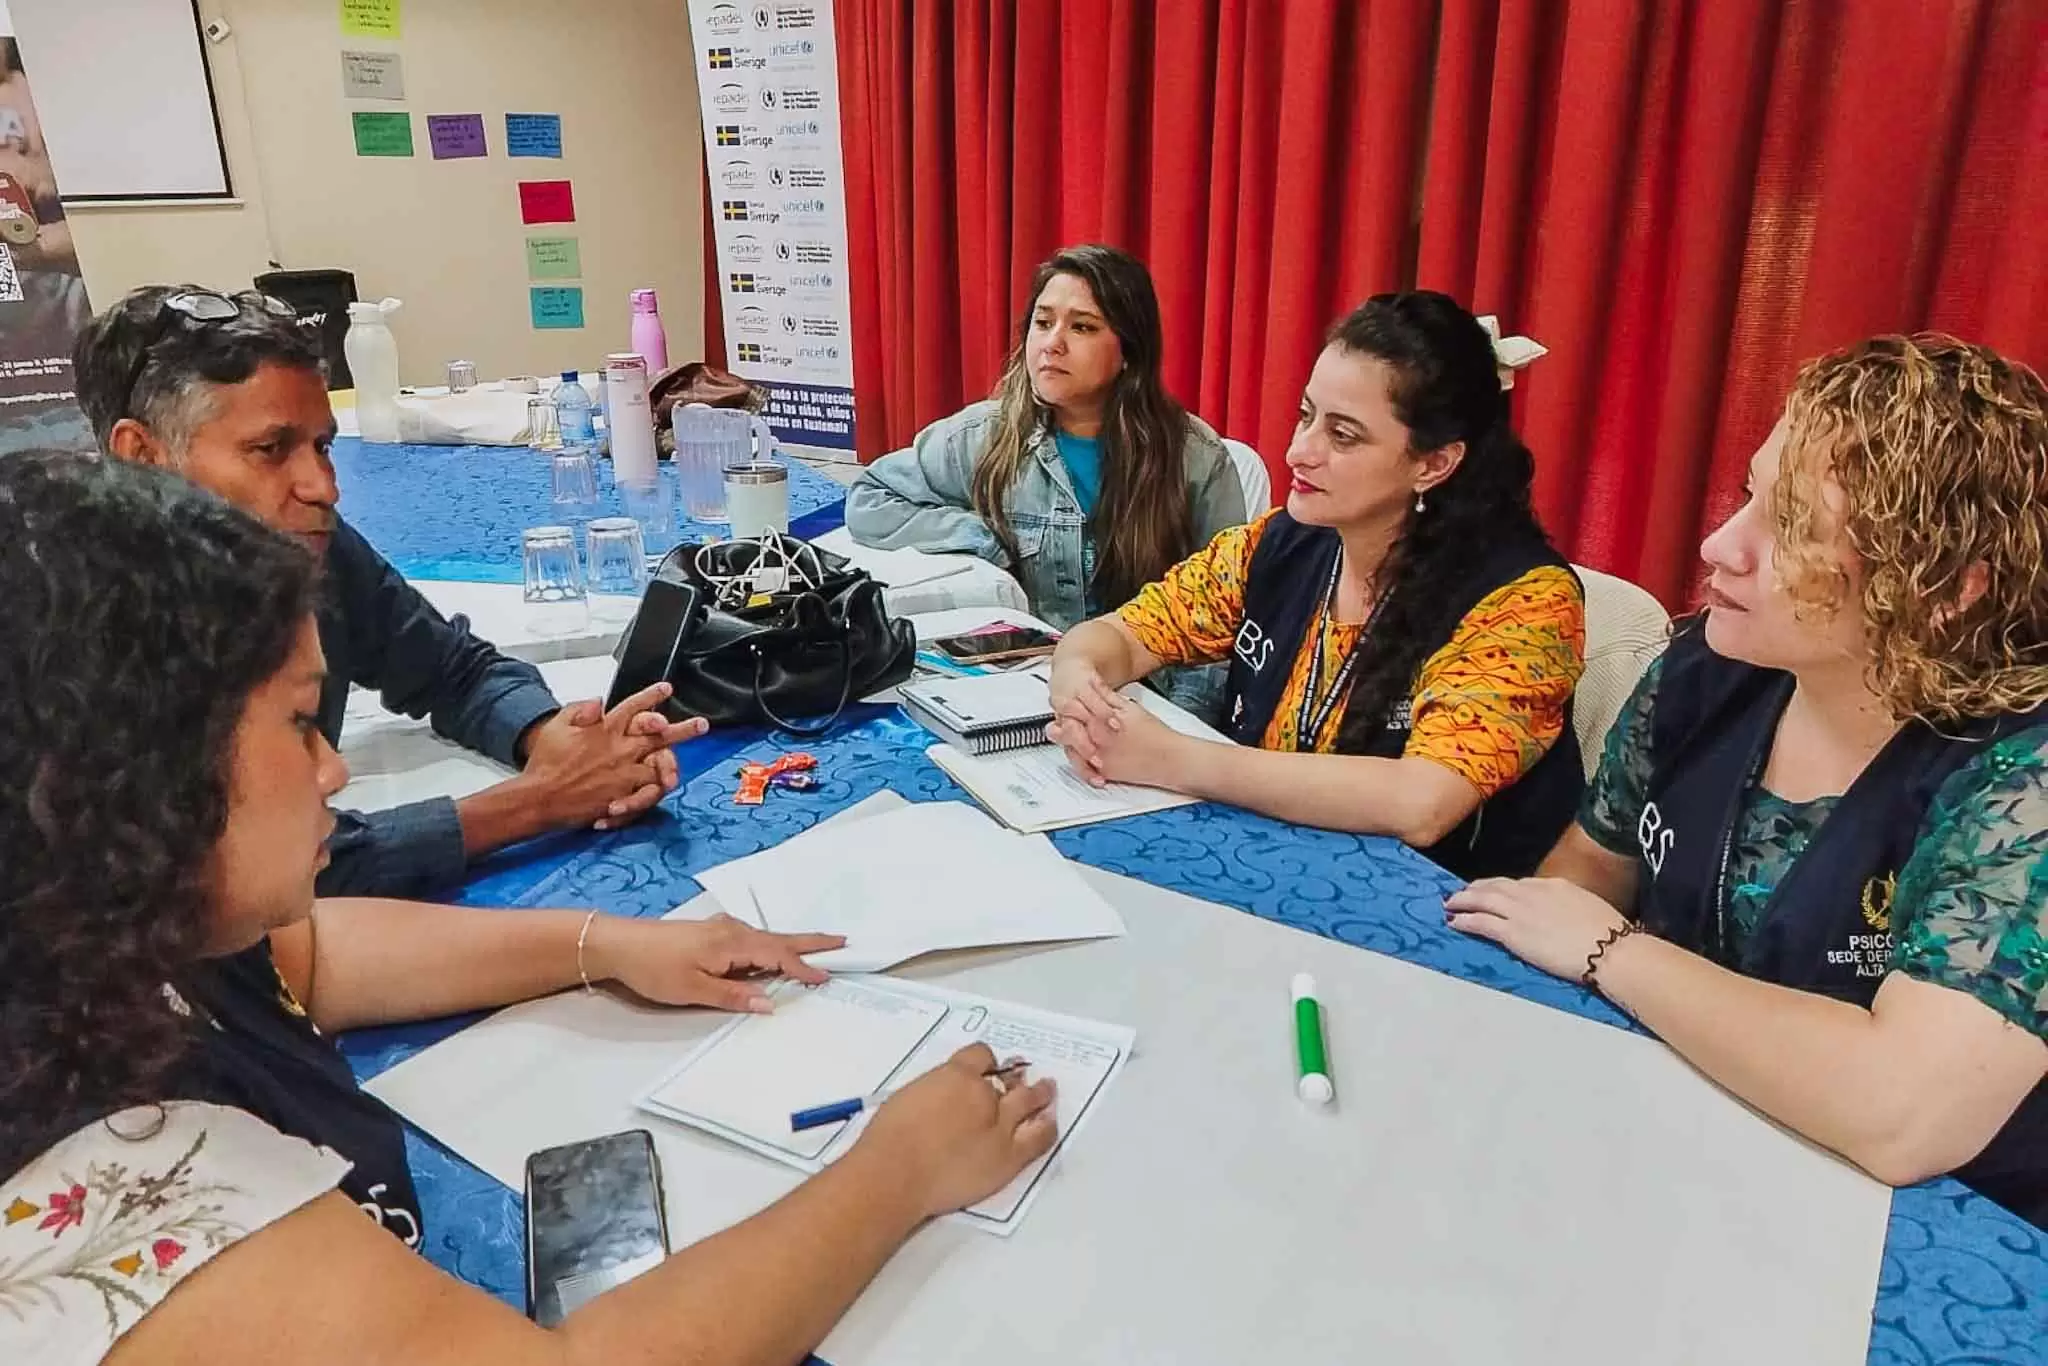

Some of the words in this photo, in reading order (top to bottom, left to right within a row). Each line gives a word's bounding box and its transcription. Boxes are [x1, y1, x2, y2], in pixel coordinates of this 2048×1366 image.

[769, 40, 799, 56] unicef
[734, 56, 766, 69] Sverige
[776, 120, 806, 136] unicef
[742, 136, 773, 148] Sverige
[783, 200, 813, 212] unicef
[750, 211, 780, 223] Sverige
[757, 283, 787, 296] Sverige
[763, 355, 793, 367] Sverige
[770, 388, 791, 400] endo
[763, 416, 790, 428] entes
[1827, 950, 1863, 964] SEDE
[1856, 964, 1885, 977] ALTA
